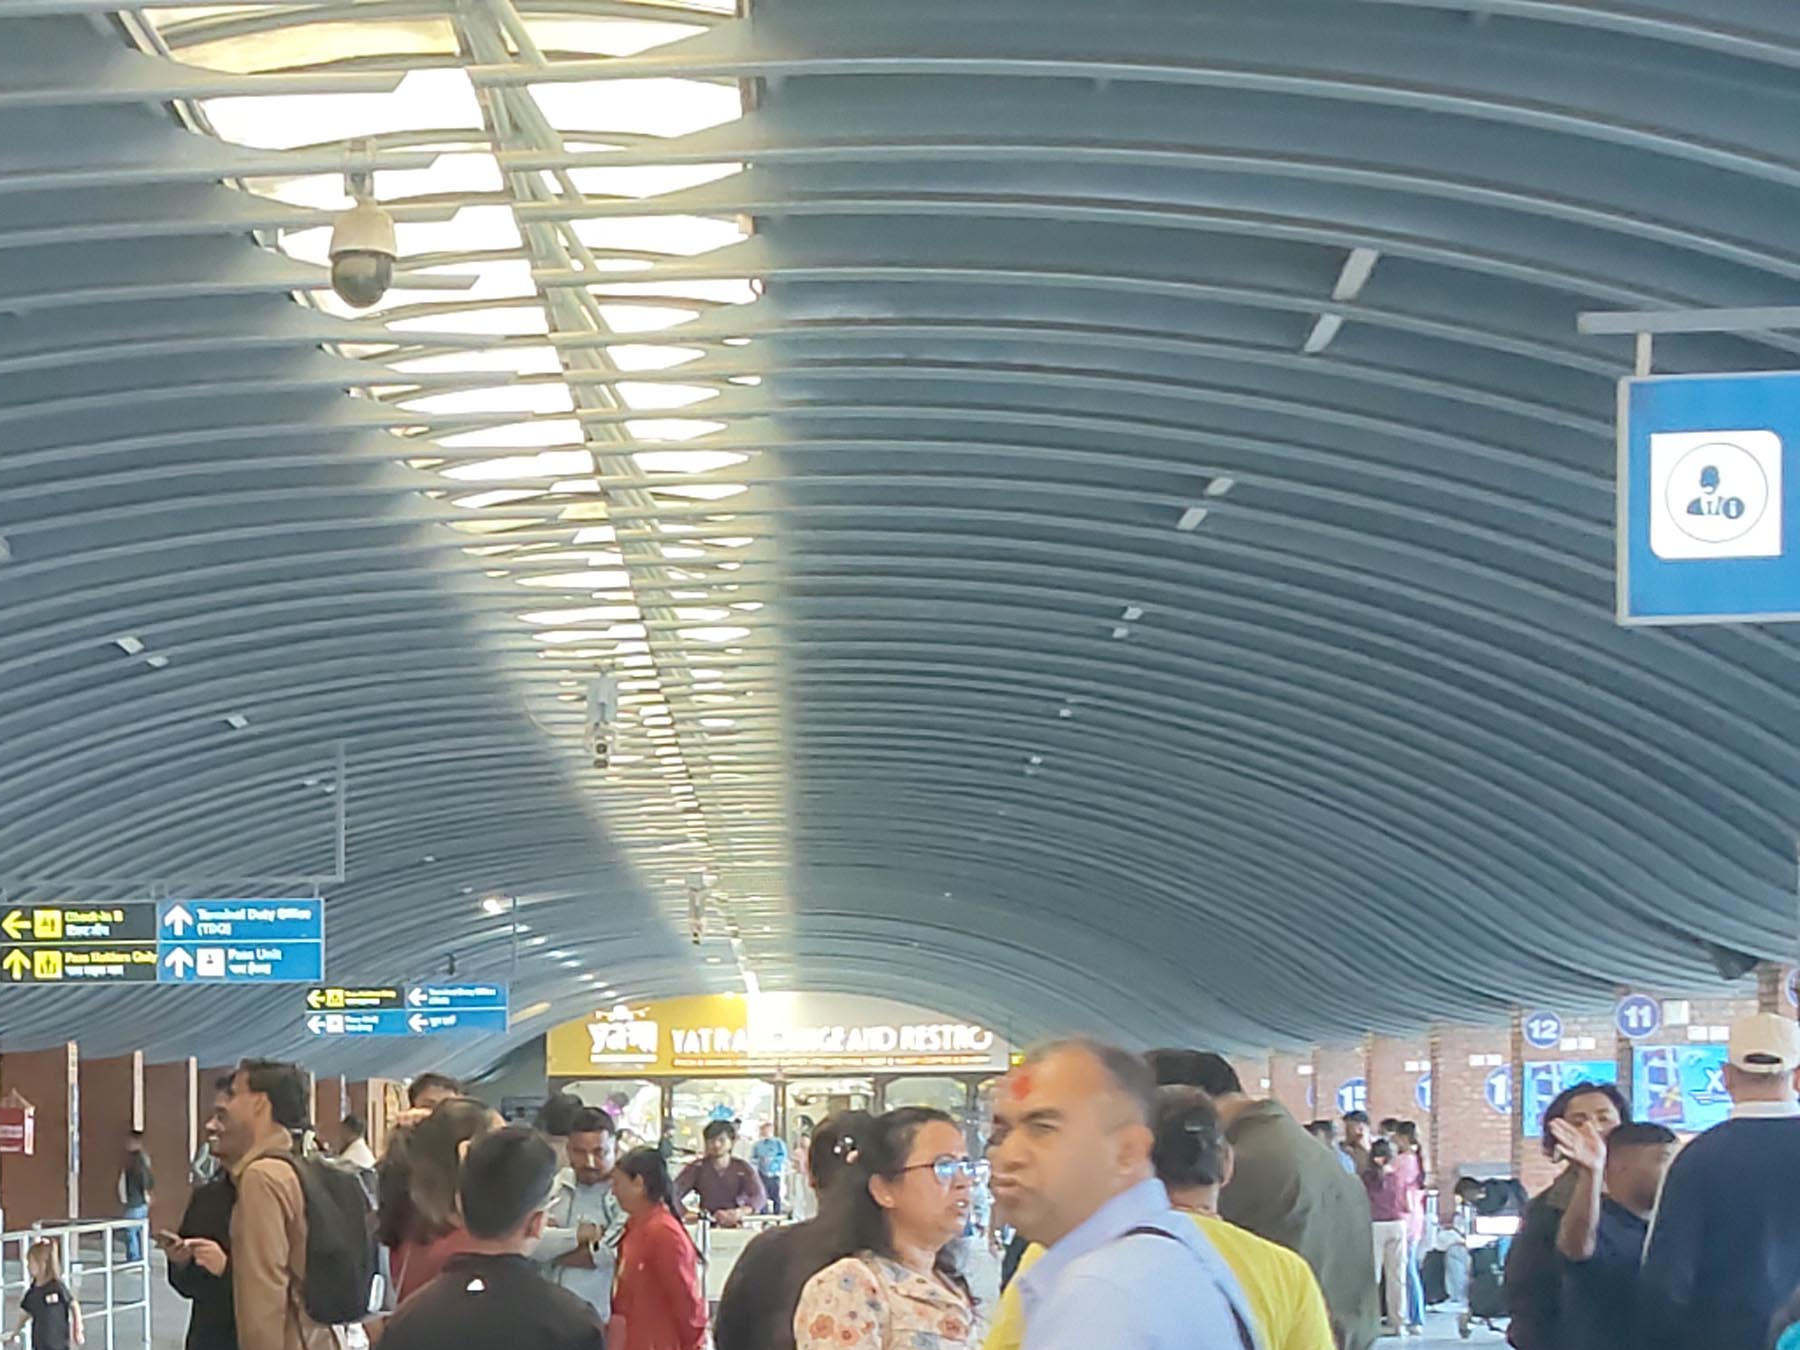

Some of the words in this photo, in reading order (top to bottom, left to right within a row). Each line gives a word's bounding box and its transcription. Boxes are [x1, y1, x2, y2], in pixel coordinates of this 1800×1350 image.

[197, 908, 246, 920] Terminal
[247, 908, 275, 922] Duty
[132, 950, 158, 964] Only
[228, 948, 254, 960] Pass
[256, 948, 282, 960] Unit
[1623, 1005, 1652, 1028] 11
[1528, 1020, 1557, 1039] 12
[671, 1027, 749, 1053] YATRA
[846, 1026, 897, 1051] AND
[899, 1025, 993, 1050] RESTRO
